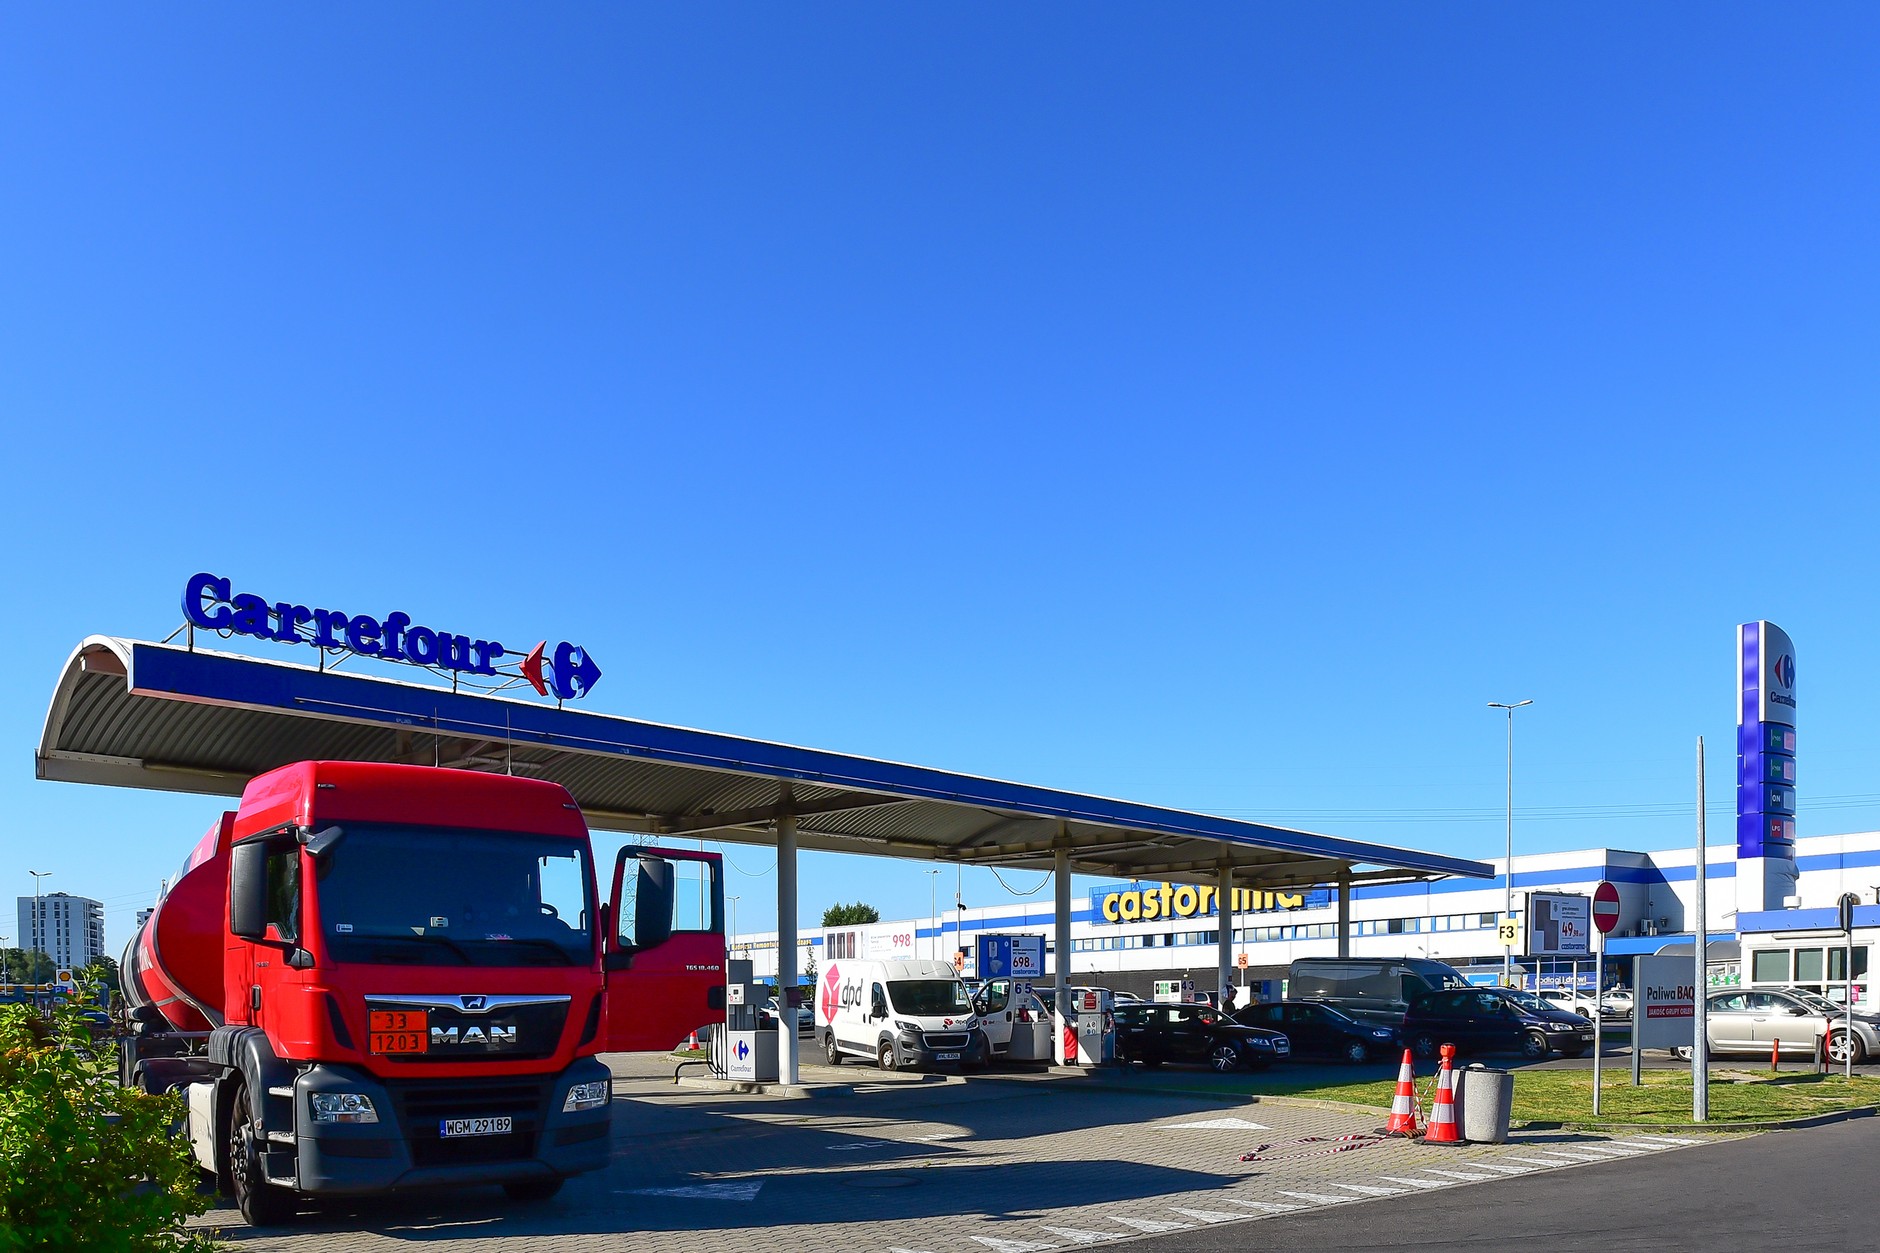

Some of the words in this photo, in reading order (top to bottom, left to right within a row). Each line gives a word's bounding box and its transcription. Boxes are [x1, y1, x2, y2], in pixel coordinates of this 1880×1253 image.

[181, 572, 505, 676] Carrefour
[1772, 794, 1781, 803] ON
[1771, 824, 1781, 833] LPG
[1499, 925, 1515, 939] F3
[892, 933, 911, 948] 998
[1012, 956, 1030, 968] 698
[1181, 980, 1188, 991] 4
[1188, 980, 1195, 991] 3
[1565, 975, 1587, 984] drwi
[842, 977, 863, 1013] dpd
[1014, 983, 1022, 995] 6
[1024, 983, 1032, 994] 5
[1647, 985, 1676, 1000] Paliwa
[385, 1013, 407, 1029] 33
[376, 1034, 419, 1050] 1203
[431, 1026, 516, 1044] MAN
[730, 1064, 752, 1073] Carrefour
[446, 1121, 471, 1135] WGM
[474, 1118, 511, 1133] 29189
